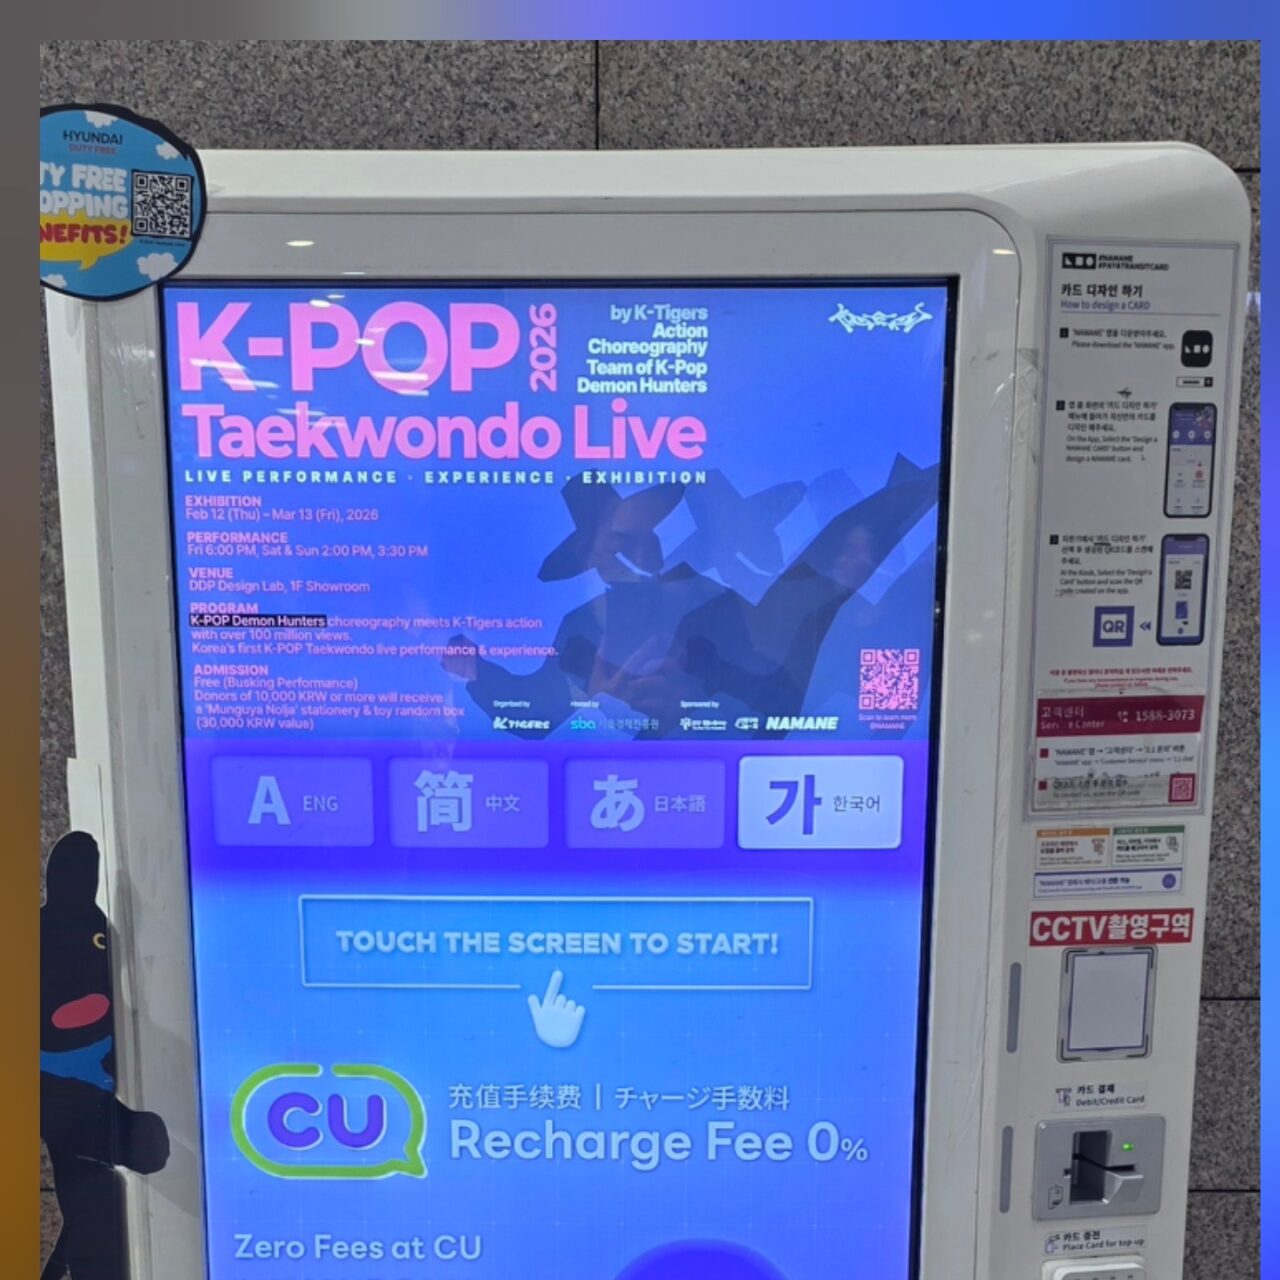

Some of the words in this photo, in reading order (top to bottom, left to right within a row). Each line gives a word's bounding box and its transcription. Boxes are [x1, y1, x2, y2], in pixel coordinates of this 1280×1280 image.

[63, 130, 124, 145] HYUNDAI
[72, 163, 127, 192] FREE
[1061, 283, 1083, 296] 카드
[1087, 284, 1118, 297] 디자인
[1122, 285, 1144, 297] 하기
[610, 304, 633, 322] by
[633, 304, 708, 322] K-Tigers
[652, 322, 708, 338] Action
[176, 301, 520, 392] K-POP
[529, 302, 558, 393] 2026
[587, 339, 708, 356] Choreography
[587, 359, 634, 375] Team
[635, 359, 653, 375] of
[655, 359, 708, 377] K-Pop
[577, 377, 637, 393] Demon
[639, 377, 708, 393] Hunters
[181, 401, 562, 461] Taekwondo
[574, 397, 707, 460] Live
[185, 470, 232, 483] LIVE
[243, 470, 397, 483] PERFORMANCE
[424, 471, 555, 484] EXPERIENCE
[582, 471, 707, 484] EXHIBITION
[185, 496, 262, 507] EXHIBITION
[187, 532, 288, 543] PERFORMANCE
[188, 567, 234, 578] VENUE
[190, 603, 259, 614] PROGRAM
[190, 615, 230, 626] K-POP
[232, 616, 275, 626] Demon
[278, 616, 326, 627] Hunters
[1102, 620, 1126, 633] QR
[193, 665, 269, 675] ADMISSION
[766, 717, 839, 730] NAMANE
[248, 776, 291, 825] A
[303, 796, 338, 811] ENG
[413, 770, 474, 832] 简
[485, 794, 520, 812] 中文
[590, 775, 645, 832] あ
[654, 794, 706, 812] 日本語
[766, 775, 822, 835] 가
[832, 795, 881, 813] 한국어
[1032, 913, 1191, 942] CCTV촬영구역
[336, 931, 437, 952] TOUCH
[444, 932, 501, 953] THE
[508, 932, 622, 954] SCREEN
[630, 933, 669, 954] TO
[677, 933, 780, 955] START!
[448, 1084, 582, 1109] 充值手续费
[614, 1085, 790, 1111] チャージ手数料
[267, 1091, 385, 1149] CU
[451, 1120, 692, 1171] Recharge
[708, 1121, 793, 1162] Fee
[807, 1121, 869, 1162] 0%
[234, 1234, 305, 1259] Zero
[314, 1235, 384, 1259] Fees
[391, 1237, 425, 1259] at
[434, 1235, 482, 1260] CU
